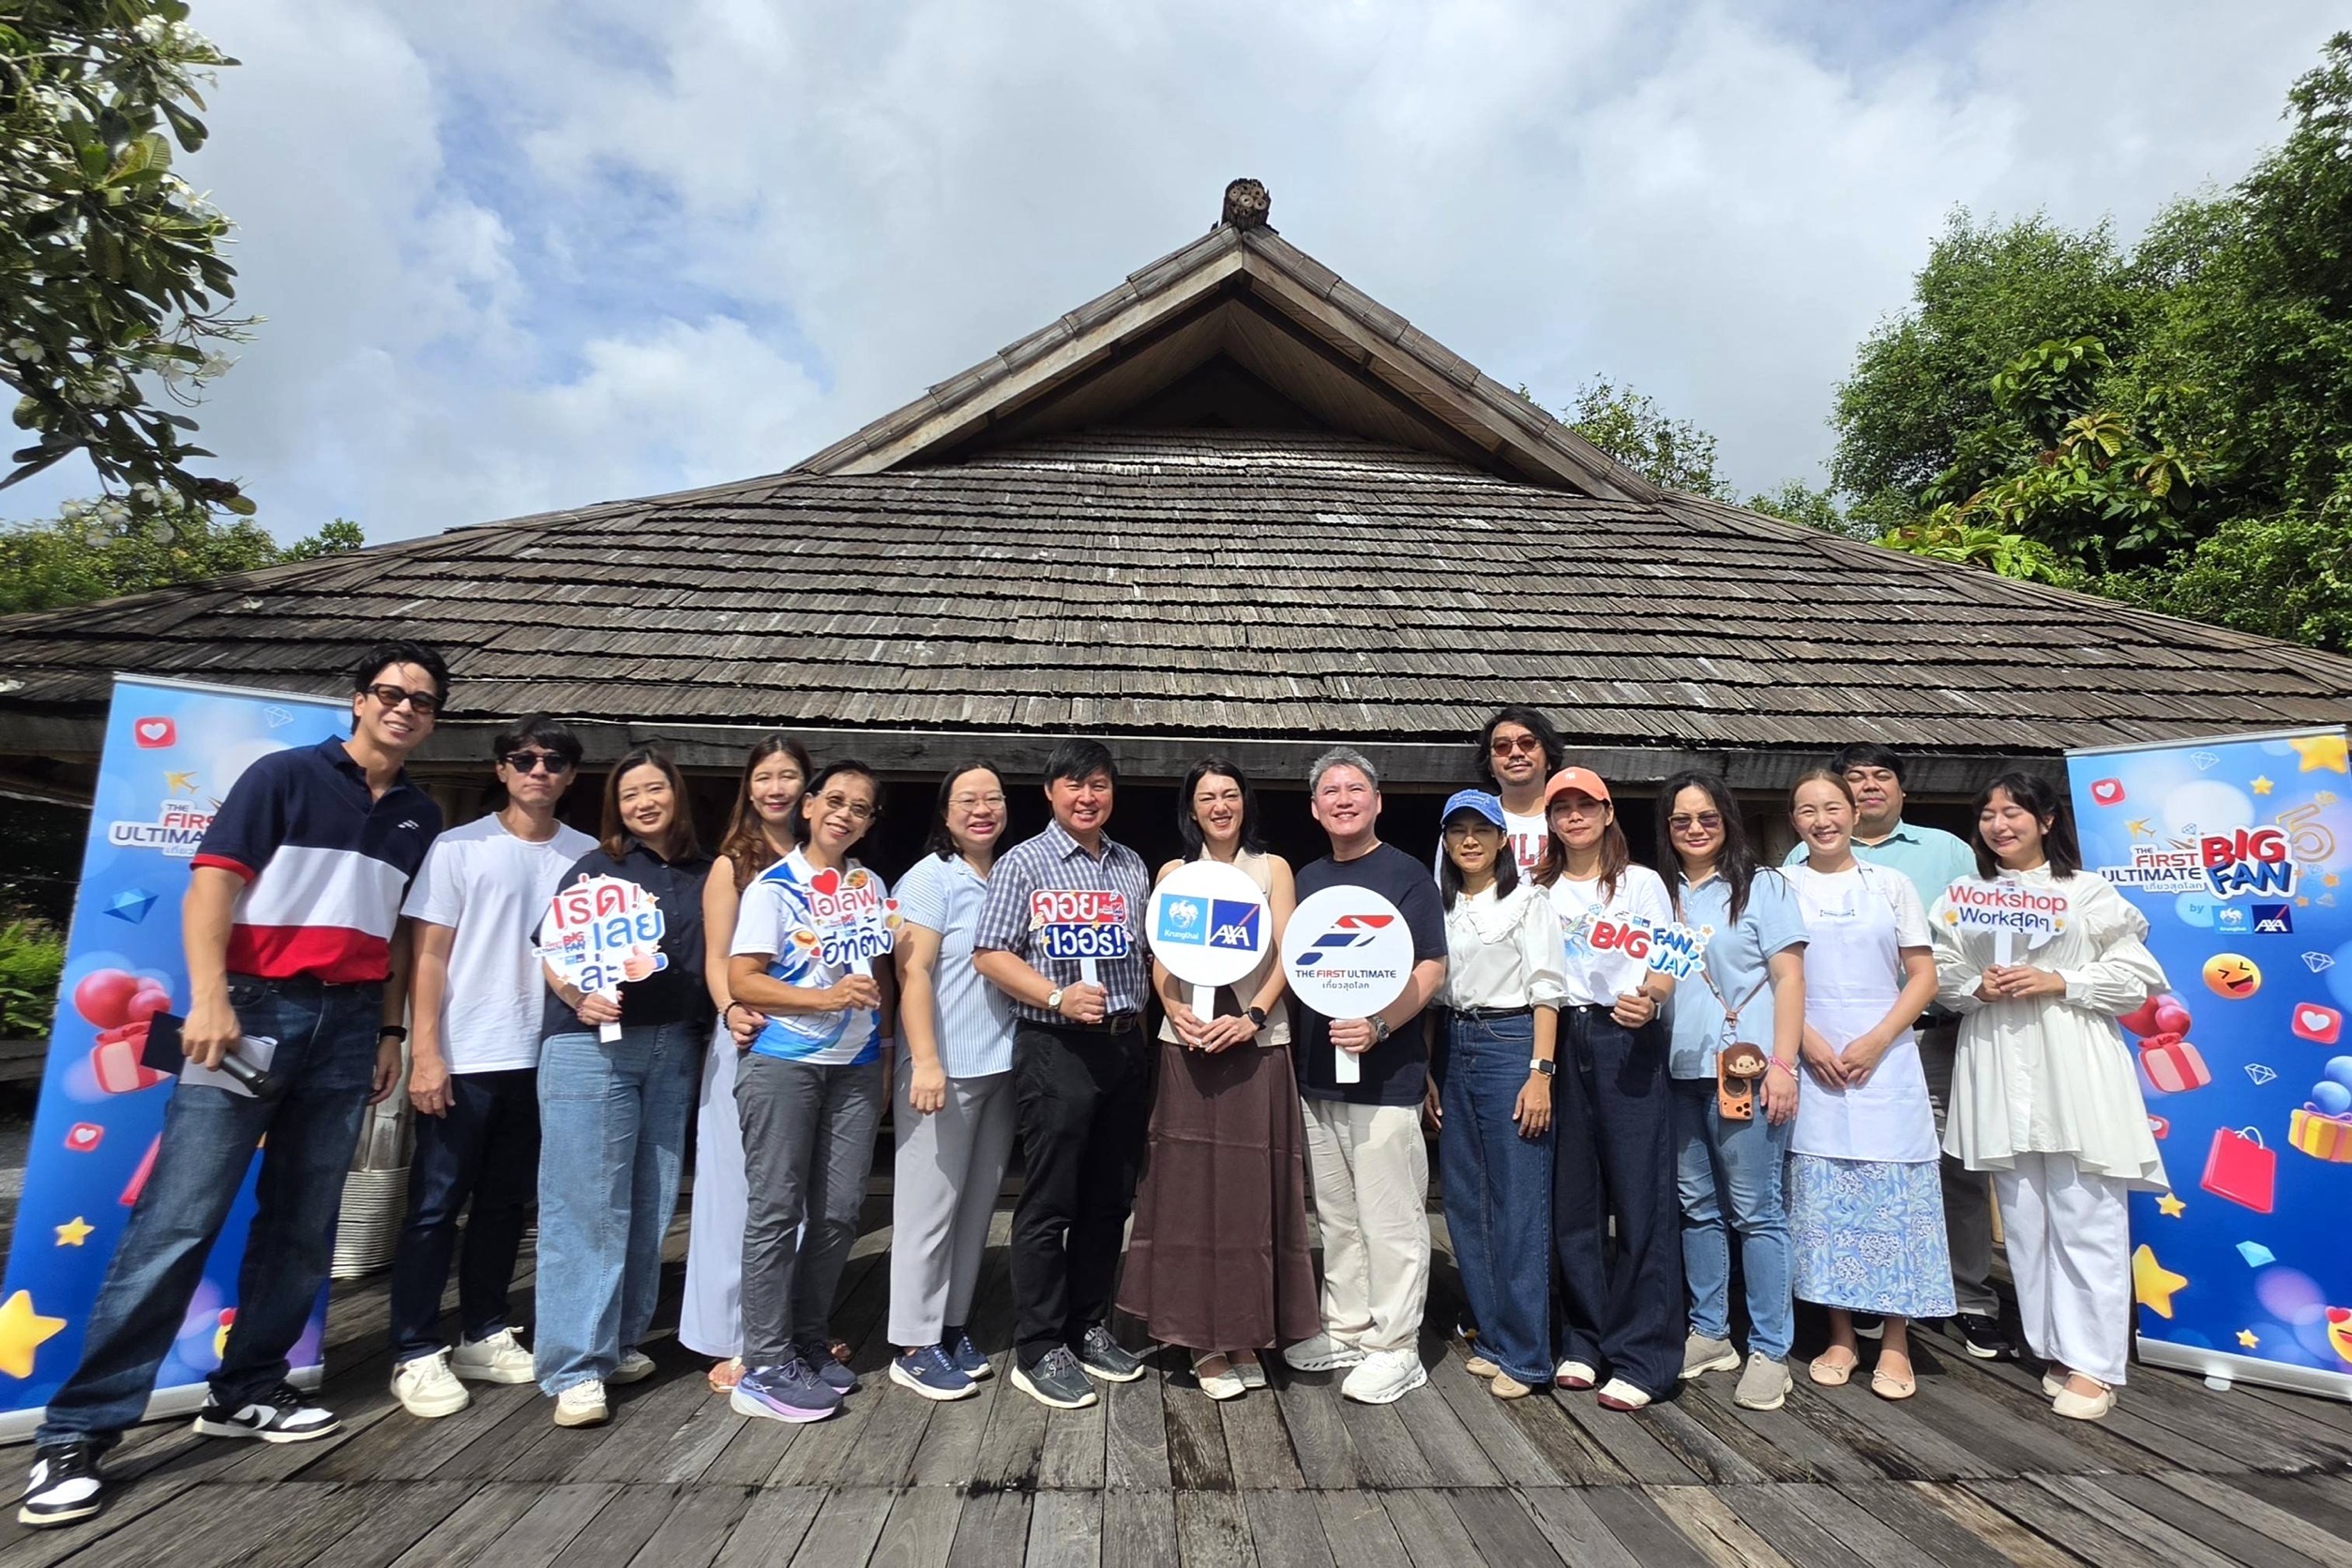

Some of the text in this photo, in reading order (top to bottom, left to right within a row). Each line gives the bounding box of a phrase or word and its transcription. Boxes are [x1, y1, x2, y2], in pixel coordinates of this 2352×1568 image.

[166, 803, 189, 812] THE
[163, 812, 215, 829] FIR
[114, 825, 205, 844] ULTIMA
[2201, 828, 2286, 868] BIG
[2135, 852, 2199, 867] FIRST
[2102, 867, 2202, 882] ULTIMATE
[2206, 860, 2292, 895] FAN
[1035, 892, 1099, 922] จอย
[1949, 885, 2068, 915] Workshop
[2189, 903, 2205, 914] by
[593, 910, 662, 951] เลย
[1164, 928, 1199, 941] Krungthai
[1210, 924, 1251, 946] AXA
[2254, 919, 2288, 932] AXA
[1052, 922, 1123, 955] เว่อร์!
[1591, 921, 1694, 959] BIG FAN
[580, 953, 619, 991] ล่ะ
[1295, 970, 1396, 978] THE FIRST ULTIMATE
[1648, 949, 1691, 978] JAI
